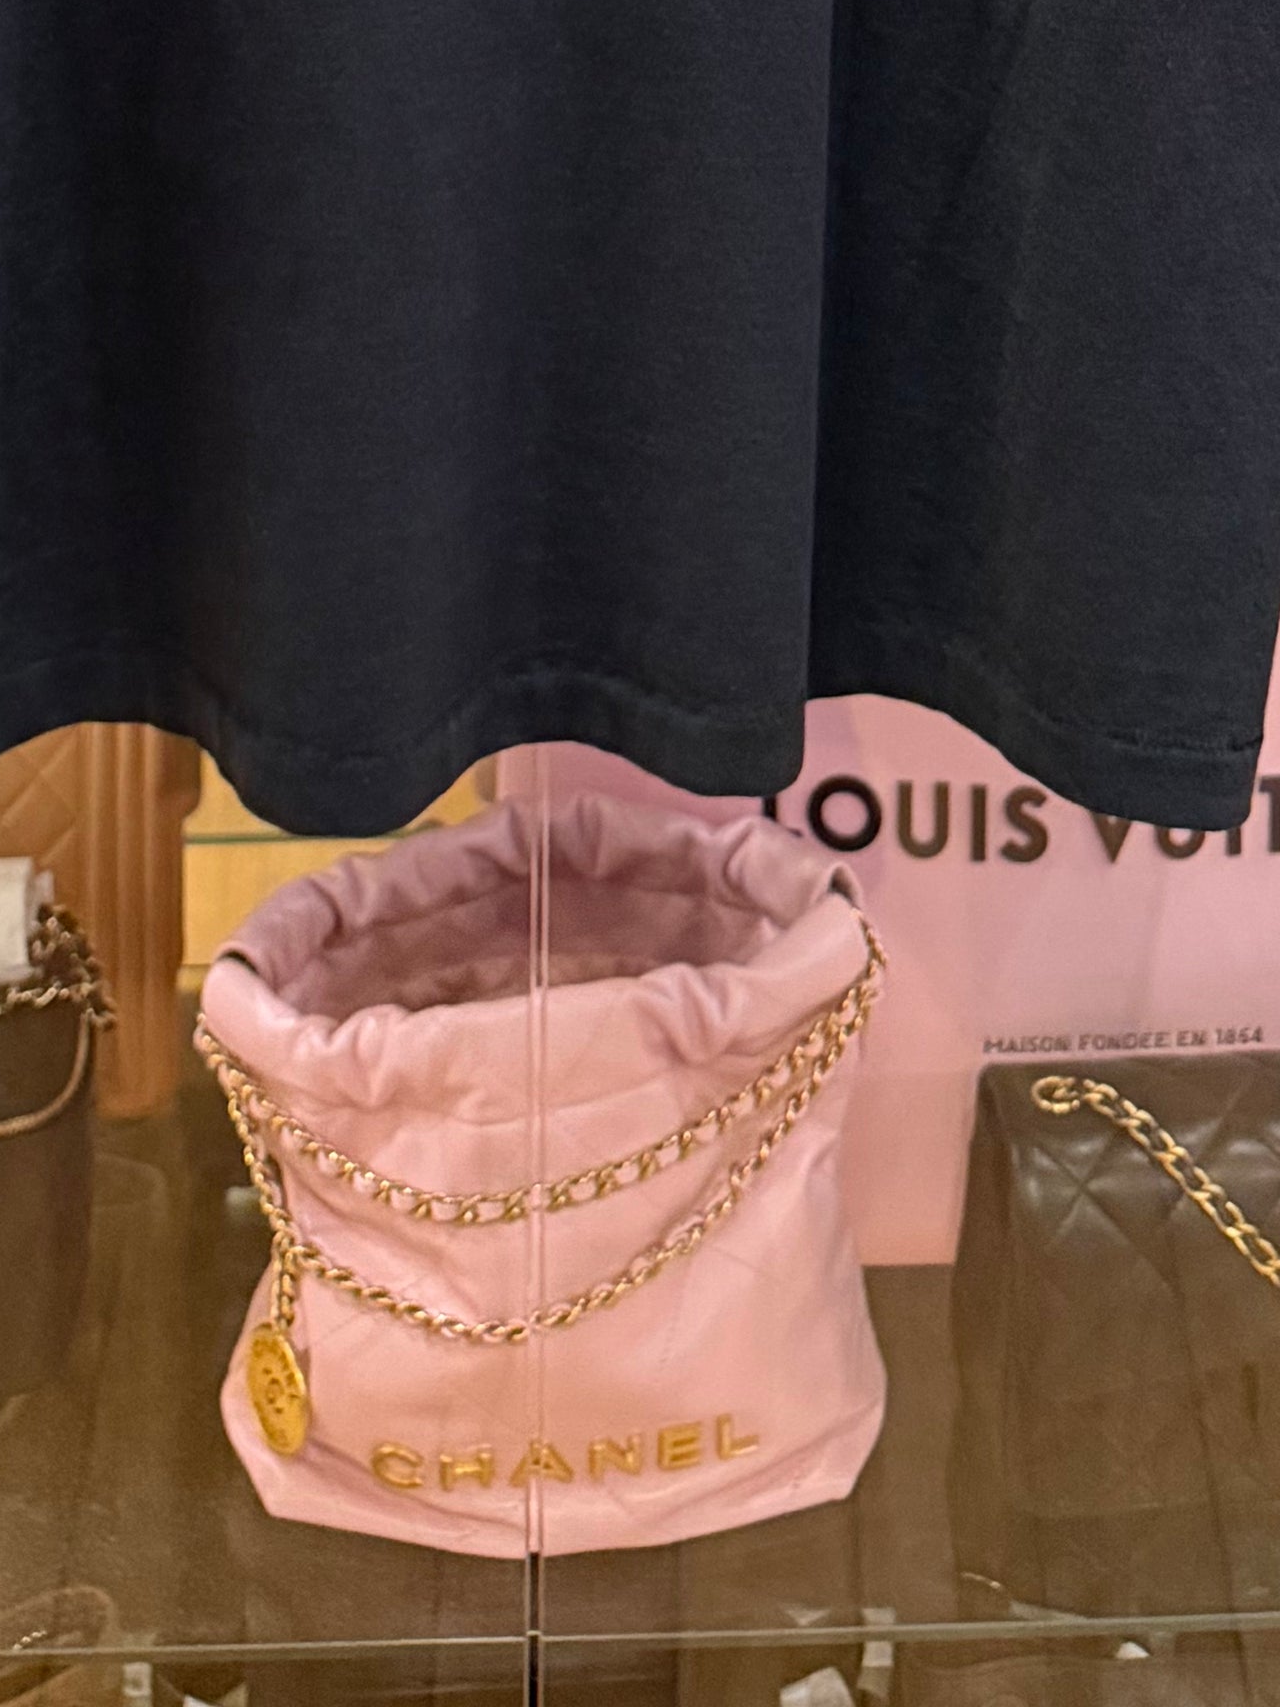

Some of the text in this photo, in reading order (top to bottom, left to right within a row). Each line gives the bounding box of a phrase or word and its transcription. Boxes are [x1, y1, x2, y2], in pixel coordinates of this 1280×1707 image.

[982, 1034, 1071, 1054] MAISON
[1176, 1030, 1207, 1047] EN
[369, 1414, 761, 1490] CHANEL
